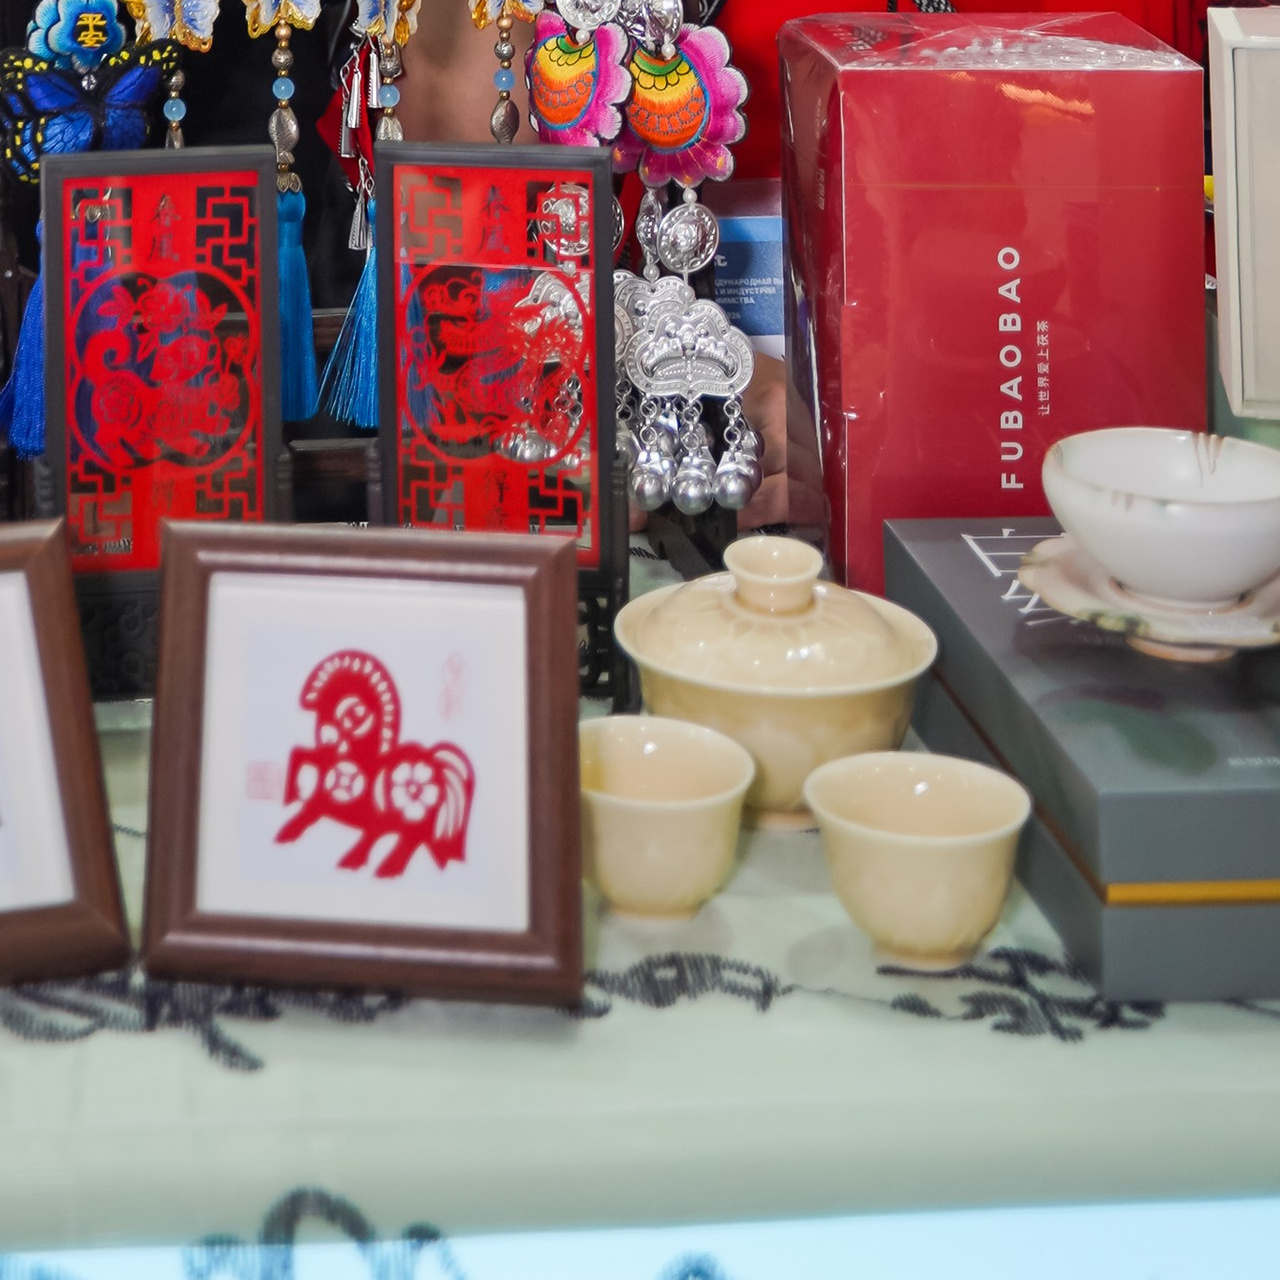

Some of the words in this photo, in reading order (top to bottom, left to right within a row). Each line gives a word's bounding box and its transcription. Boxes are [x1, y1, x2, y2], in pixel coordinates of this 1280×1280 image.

[997, 246, 1024, 490] FUBAOBAO
[1036, 320, 1051, 417] 让世界爱上茯茶
